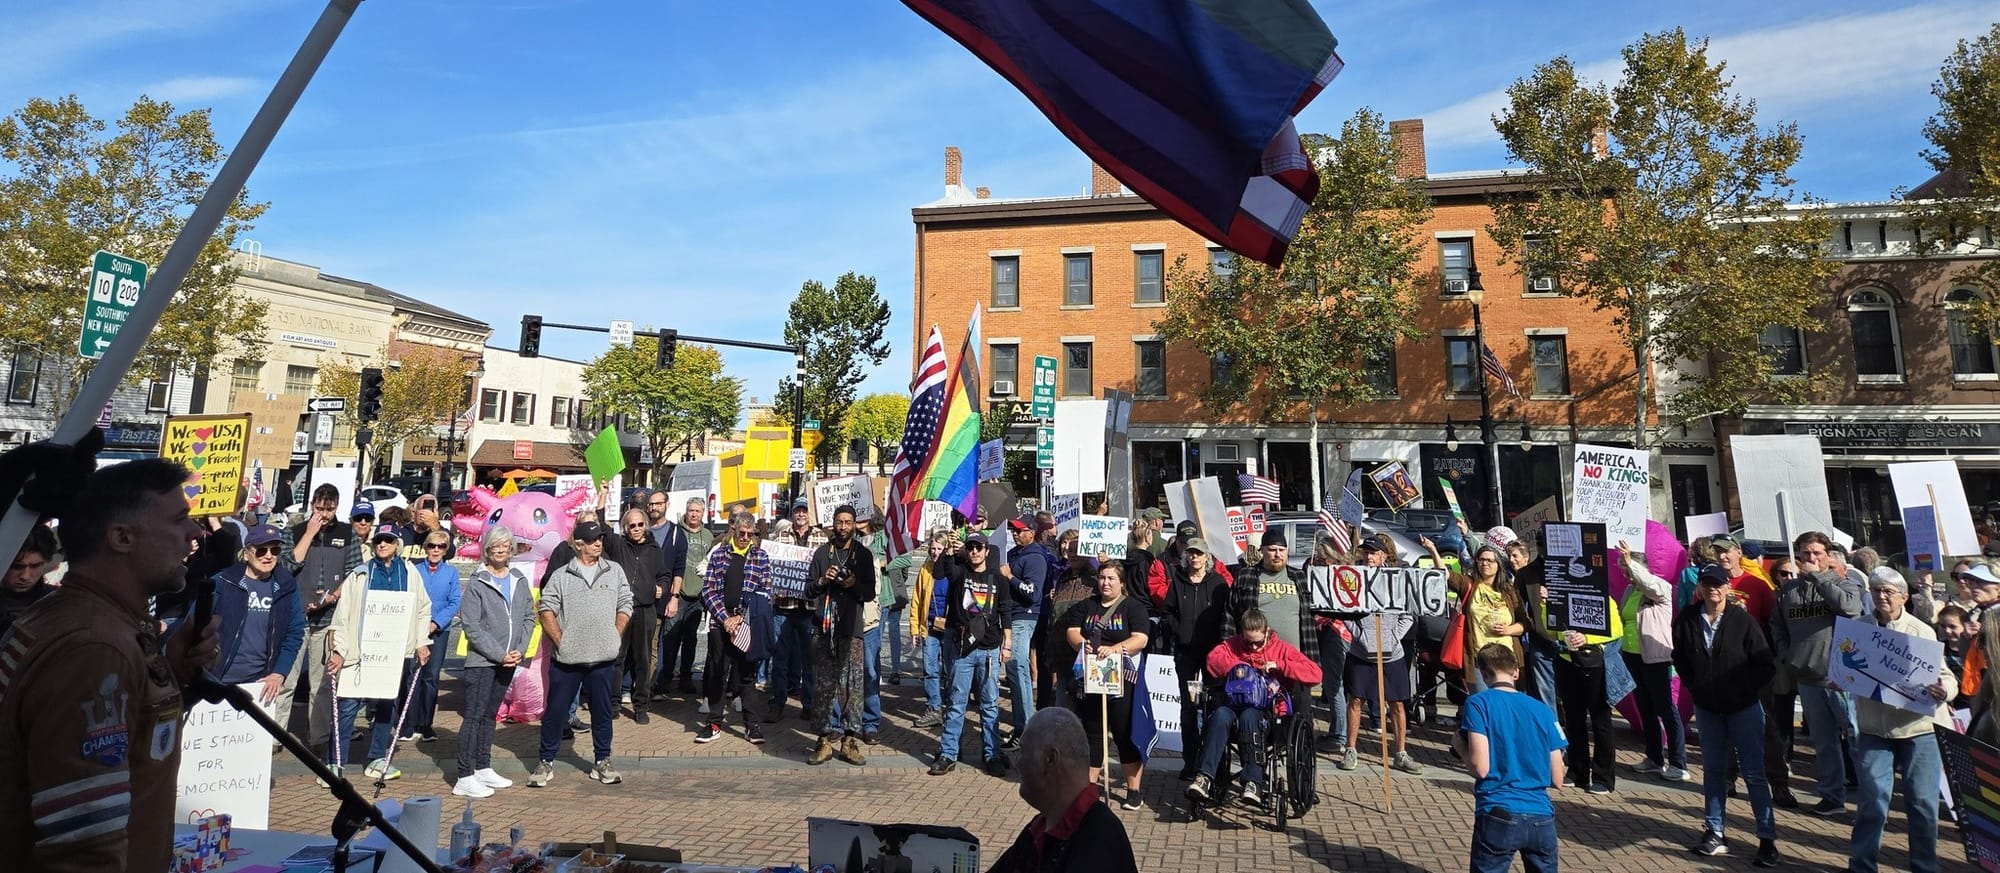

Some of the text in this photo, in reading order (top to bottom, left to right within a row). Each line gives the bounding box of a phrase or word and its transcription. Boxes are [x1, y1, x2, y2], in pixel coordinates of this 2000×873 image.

[112, 259, 132, 274] SOUTH
[98, 279, 110, 295] 10
[119, 283, 138, 301] 202
[87, 319, 122, 334] NEW HAVE
[300, 313, 345, 332] NATIONAL
[349, 322, 374, 337] BANK
[172, 424, 242, 440] We USA
[1808, 428, 1983, 438] PIGNATARE & SAGAN
[170, 441, 190, 454] We
[209, 439, 241, 452] Truth
[412, 444, 433, 456] CAFE
[789, 459, 805, 469] 25
[1576, 451, 1641, 470] AMERICA,
[1583, 465, 1648, 484] NO KINGS
[833, 482, 855, 492] TRUMP
[1618, 482, 1632, 492] FOR
[819, 491, 862, 505] HAVE YOU NO
[1576, 487, 1594, 496] YOUR
[1595, 489, 1628, 500] ATTENTION
[1576, 494, 1591, 505] THIS
[199, 497, 231, 509] Law
[847, 500, 859, 508] OF
[928, 503, 948, 513] JUSTI
[1252, 513, 1264, 521] THE
[1081, 519, 1126, 530] HANDS OFF
[1230, 525, 1247, 533] LOVE
[1089, 531, 1104, 539] OUR
[763, 542, 815, 562] NO KINGS
[1259, 582, 1298, 596] BRUH
[365, 603, 378, 614] NO
[1584, 615, 1604, 626] KINGS
[373, 631, 381, 639] IN
[1872, 631, 1935, 673] Rebalance
[1159, 667, 1174, 676] HE
[1879, 654, 1917, 682] Now!
[186, 708, 247, 727] NITED
[1158, 720, 1181, 731] THI
[210, 732, 255, 749] STAND
[198, 758, 224, 772] FOR
